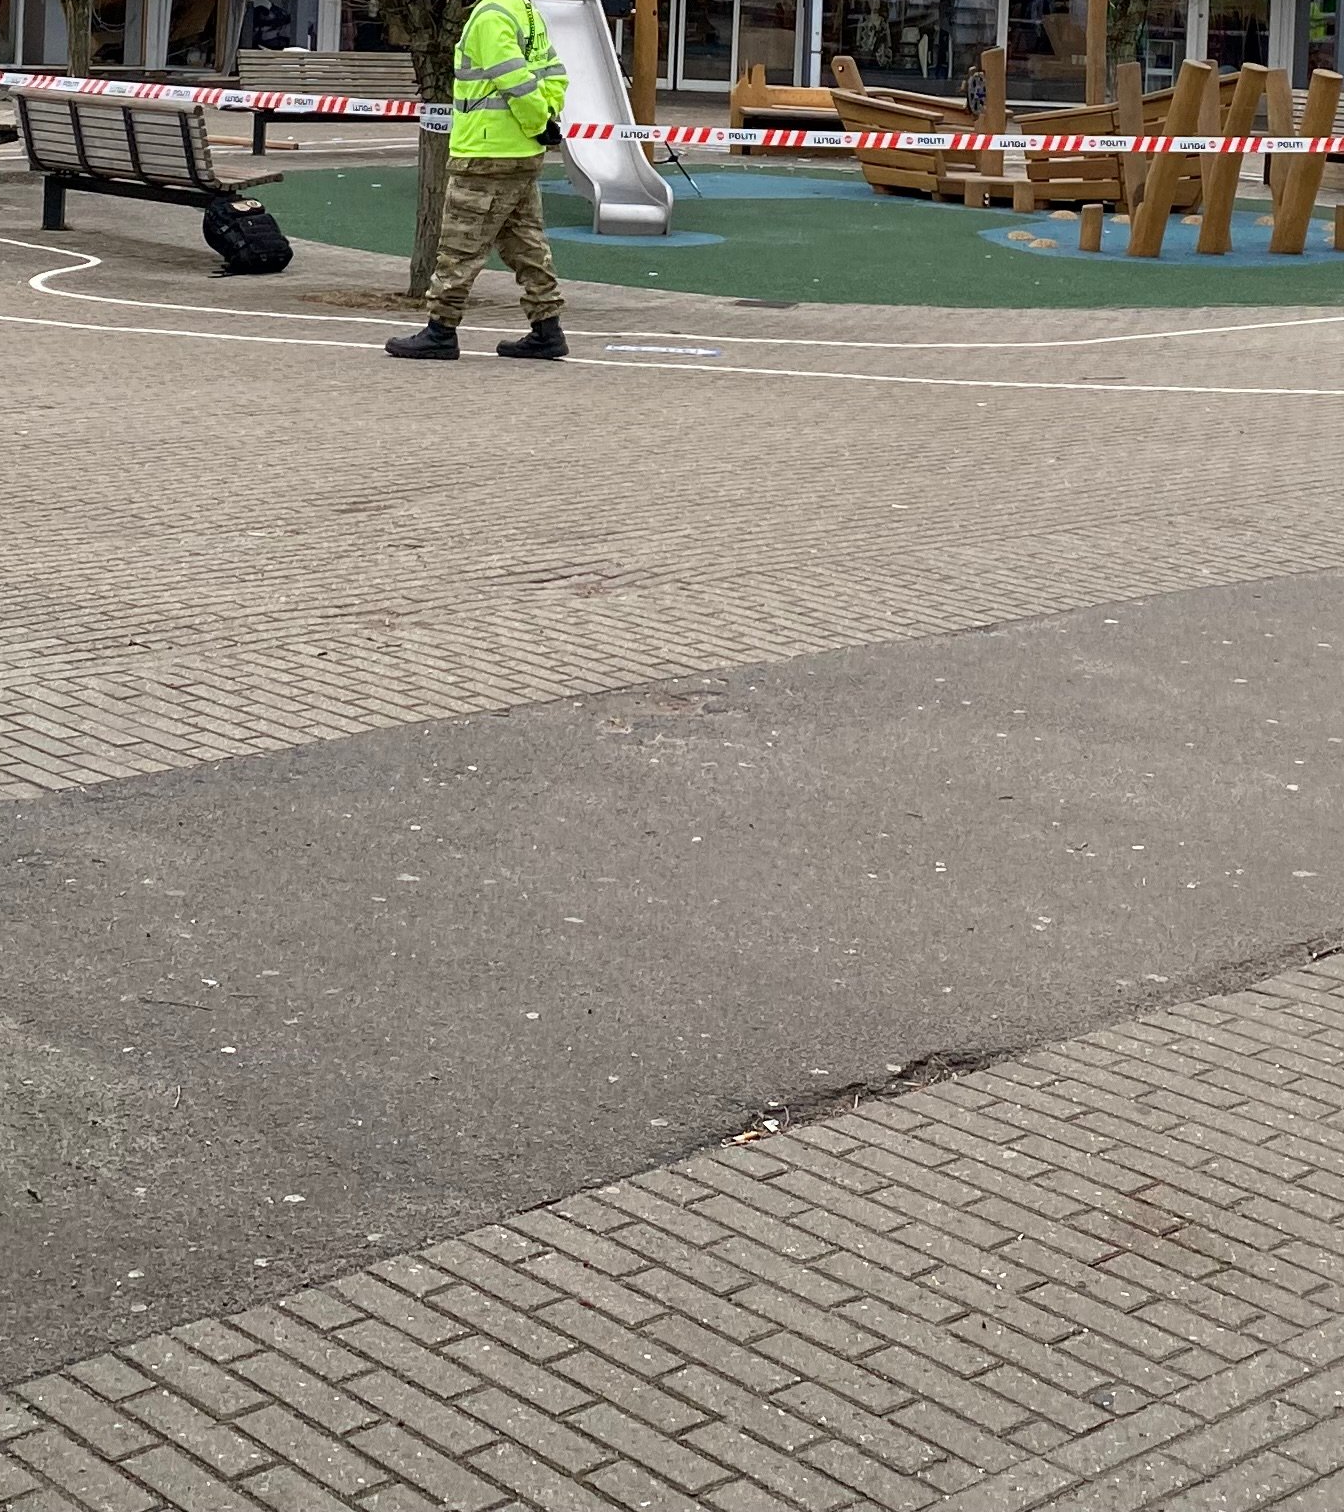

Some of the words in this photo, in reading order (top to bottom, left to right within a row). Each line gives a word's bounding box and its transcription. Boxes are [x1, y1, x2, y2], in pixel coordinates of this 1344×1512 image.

[620, 130, 650, 139] POLITI
[728, 132, 757, 141] POLITI
[813, 136, 841, 145] POLITI
[917, 137, 945, 145] POLITI
[999, 140, 1027, 148] POLITI
[1100, 139, 1127, 148] POLITI
[1179, 142, 1206, 150] POLITI
[1277, 141, 1304, 149] POLITI
